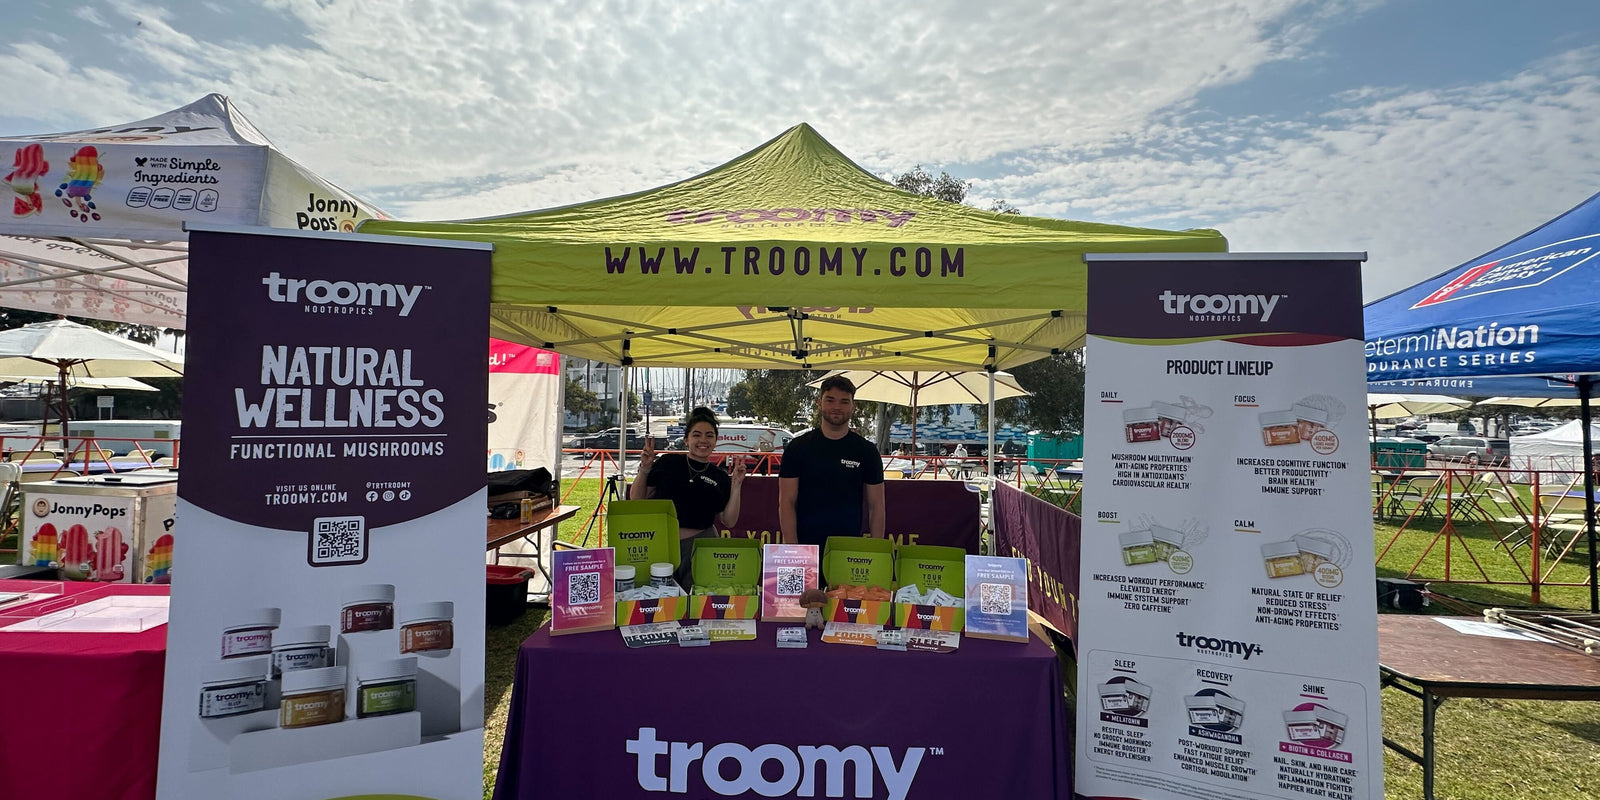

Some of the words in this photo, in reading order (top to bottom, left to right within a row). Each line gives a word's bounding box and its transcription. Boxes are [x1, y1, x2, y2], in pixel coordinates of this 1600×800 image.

[169, 157, 221, 173] Simple
[134, 170, 219, 186] Ingredients
[307, 193, 358, 218] Jonny
[296, 212, 338, 231] Pops
[664, 208, 917, 228] troomy
[604, 246, 965, 279] WWW.TROOMY.COM
[1493, 246, 1593, 272] American
[262, 272, 423, 317] troomy
[304, 305, 374, 315] NOOTROPICS
[1158, 290, 1280, 322] troomy
[1364, 322, 1538, 358] etermiNation
[260, 345, 424, 387] NATURAL
[1166, 360, 1223, 375] PRODUCT
[1227, 360, 1274, 376] LINEUP
[1369, 356, 1447, 373] DURANCE
[1458, 351, 1536, 367] SERIES
[1100, 391, 1118, 399] DAILY
[1234, 395, 1256, 403] FOCUS
[234, 388, 445, 428] WELLNESS
[718, 434, 747, 442] akult
[230, 443, 336, 460] FUNCTIONAL
[343, 441, 444, 457] MUSHROOMS
[1111, 453, 1147, 461] MUSHROOM
[1148, 455, 1192, 463] MULTIVITAMIN
[1236, 457, 1275, 466] INCREASED
[1276, 459, 1310, 468] COGNITIVE
[1312, 460, 1347, 469] FUNCTION
[1114, 462, 1149, 470] ANTI-AGING
[1150, 464, 1188, 472] PROPERTIES
[1254, 467, 1280, 476] BETTER
[1281, 469, 1329, 478] PRODUCTIVITY
[1141, 472, 1185, 480] ANTIOXIDANTS
[1268, 477, 1288, 485] BRAIN
[1289, 478, 1315, 486] HEALTH
[311, 483, 337, 491] ONLINE
[366, 481, 411, 489] @TRYTROOMY
[1112, 479, 1165, 488] CARDIOVASCULAR
[1166, 481, 1190, 489] HEALTH
[1261, 486, 1290, 494] IMMUNE
[1291, 487, 1322, 495] SUPPORT
[265, 491, 348, 505] TROOMY.COM
[50, 502, 126, 519] JonnyPops
[1097, 511, 1118, 519] BOOST
[1234, 519, 1255, 528] CALM
[618, 531, 656, 540] troomy
[627, 546, 649, 554] YOUR
[713, 552, 739, 560] troomy
[847, 556, 872, 565] troomy
[918, 563, 945, 572] troomy
[1093, 573, 1126, 583] INCREASED
[1128, 576, 1157, 586] WORKOUT
[1159, 579, 1205, 589] PERFORMANCE
[1037, 565, 1068, 612] YOUR
[1120, 585, 1150, 594] ELEVATED
[1152, 587, 1176, 596] ENERGY
[1251, 587, 1281, 597] NATURAL
[1283, 590, 1304, 599] STATE
[1305, 591, 1315, 600] OF
[1316, 593, 1342, 602] RELIEF
[711, 602, 735, 610] troomy
[1107, 592, 1133, 601] IMMUNE
[1134, 594, 1160, 604] SYSTEM
[1161, 596, 1189, 606] SUPPORT
[1265, 598, 1297, 607] REDUCED
[1298, 600, 1327, 610] STRESS
[355, 609, 383, 617] troomy
[639, 605, 663, 613] troomy
[844, 606, 867, 615] troomy
[1124, 602, 1140, 610] ZERO
[1141, 604, 1172, 613] CAFFEINE
[1257, 606, 1303, 617] NON-DROWSY
[1305, 610, 1337, 621] EFFECTS
[917, 613, 941, 621] troomy
[1255, 615, 1294, 626] ANTI-AGING
[1295, 620, 1339, 631] PROPERTIES
[415, 629, 443, 637] troomy
[834, 631, 873, 640] FOCUS
[908, 637, 947, 646] SLEEP
[1176, 632, 1263, 660] troomy+
[1114, 659, 1136, 669] SLEEP
[1196, 668, 1233, 682] RECOVERY
[1302, 684, 1326, 695] SHINE
[295, 701, 328, 711] troomy
[1111, 715, 1141, 725] MELATONIN
[1101, 726, 1125, 736] RESTFUL
[1126, 730, 1144, 739] SLEEP
[1198, 729, 1240, 743] ASHWAGANDHA
[1099, 740, 1120, 750] IMMUNE
[1121, 743, 1146, 754] BOOSTER
[1102, 733, 1122, 743] GROGGY
[1124, 736, 1152, 748] MORNINGS
[1094, 746, 1114, 756] ENERGY
[1115, 749, 1152, 762] REPLENISHER
[1178, 738, 1222, 754] POST-WORKOUT
[1224, 748, 1251, 759] SUPPORT
[1288, 744, 1308, 754] BIOTIN
[1316, 748, 1349, 761] COLLAGEN
[626, 727, 926, 800] troomy
[1184, 748, 1198, 757] FAST
[1199, 750, 1222, 762] FATIGUE
[1224, 755, 1245, 765] RELIEF
[1173, 753, 1203, 766] ENHANCED
[1205, 759, 1229, 771] MUSCLE
[1230, 764, 1256, 776] GROWTH
[1309, 762, 1322, 771] AND
[1323, 764, 1338, 774] HAIR
[1340, 767, 1357, 777] CARE
[1181, 762, 1209, 775] CORTISOL
[1210, 768, 1248, 782] MODULATION
[1280, 765, 1314, 778] NATURALLY
[1316, 771, 1351, 785] HYDRATING
[1277, 773, 1324, 788] INFLAMMATION
[1326, 781, 1353, 794] FIGHTER
[1278, 781, 1305, 793] HAPPIER
[1306, 787, 1326, 798] HEART
[1327, 790, 1352, 800] HEALTH
